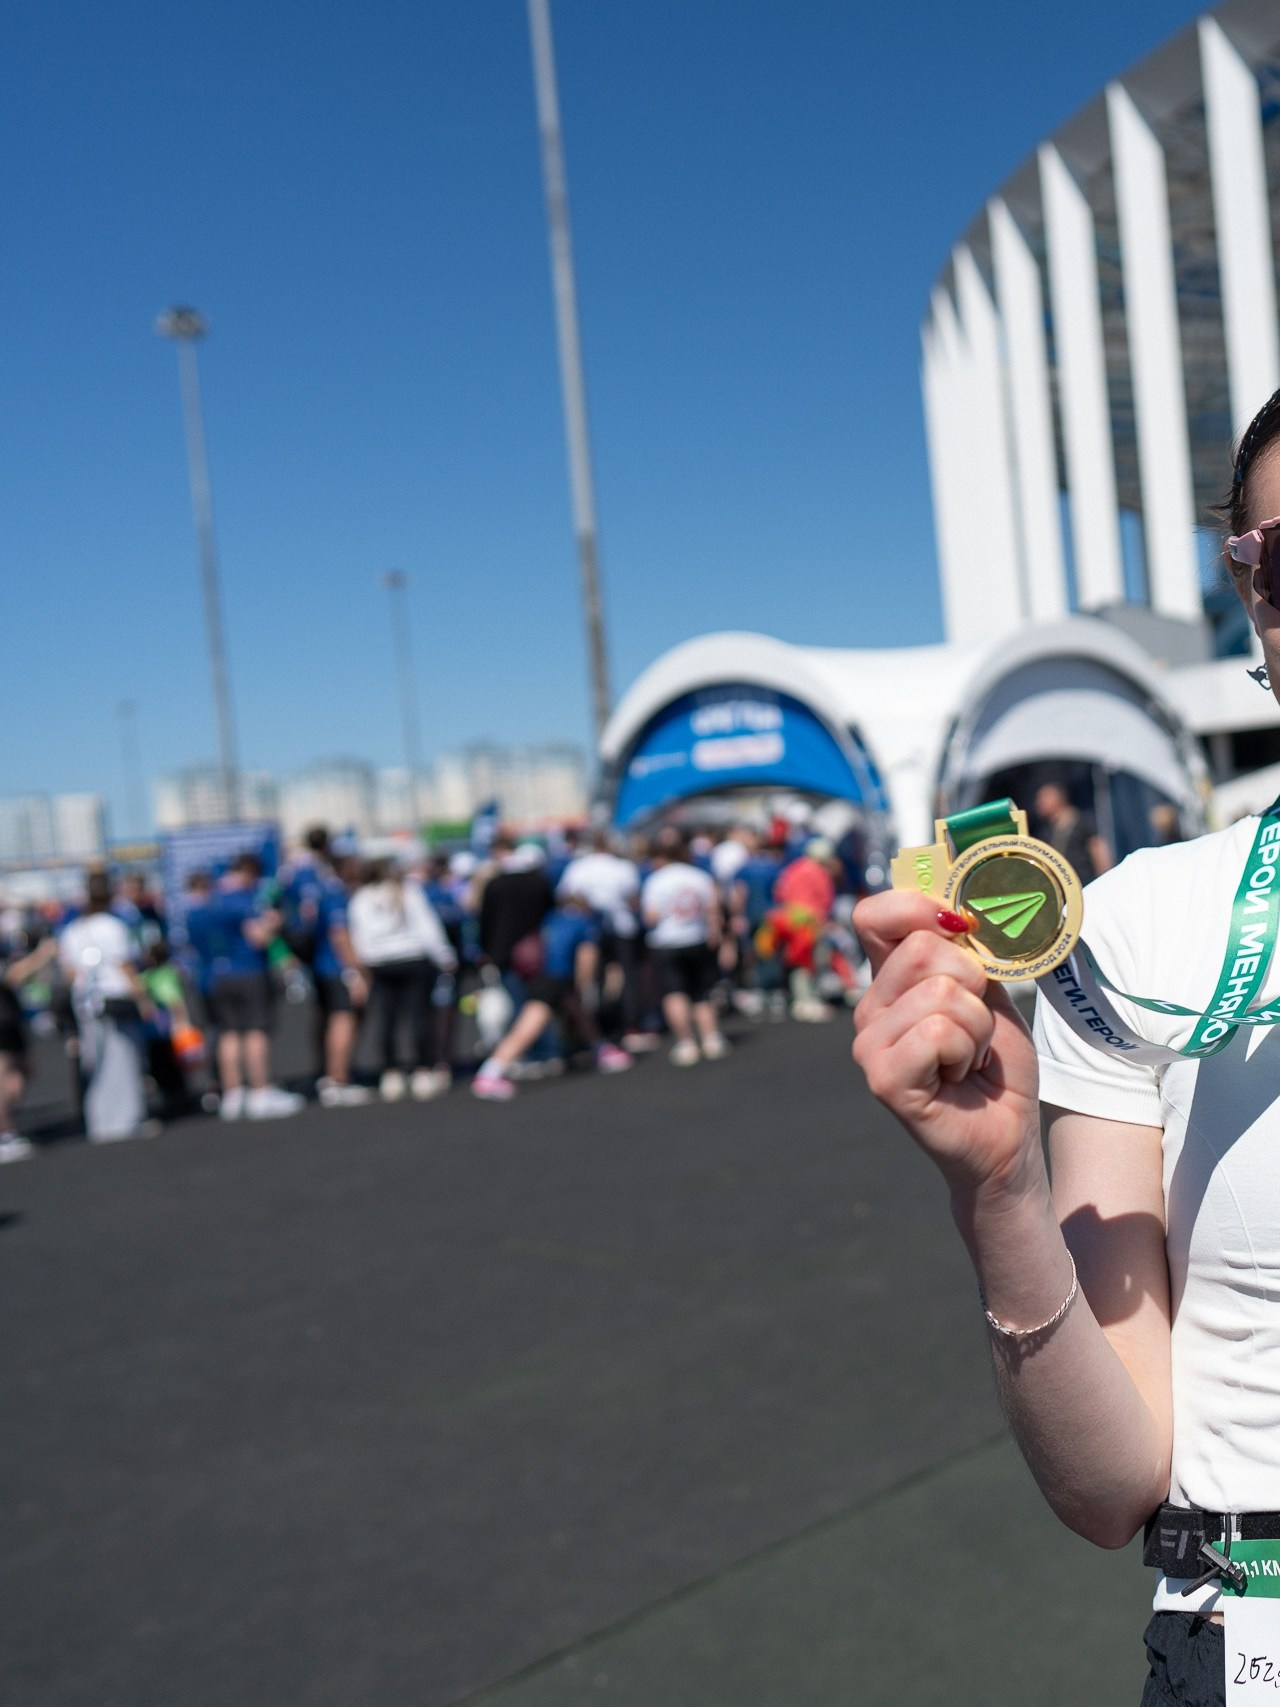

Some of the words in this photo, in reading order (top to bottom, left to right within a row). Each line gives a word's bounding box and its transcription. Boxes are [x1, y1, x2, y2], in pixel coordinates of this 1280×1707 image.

[1020, 840, 1073, 885] ПОЛУМАРАФОН
[1000, 954, 1057, 977] НОВГОРОД
[1055, 933, 1073, 955] 2024
[1053, 963, 1088, 1007] ЕГИ,
[1189, 921, 1268, 1054] МЕНЯЮТ
